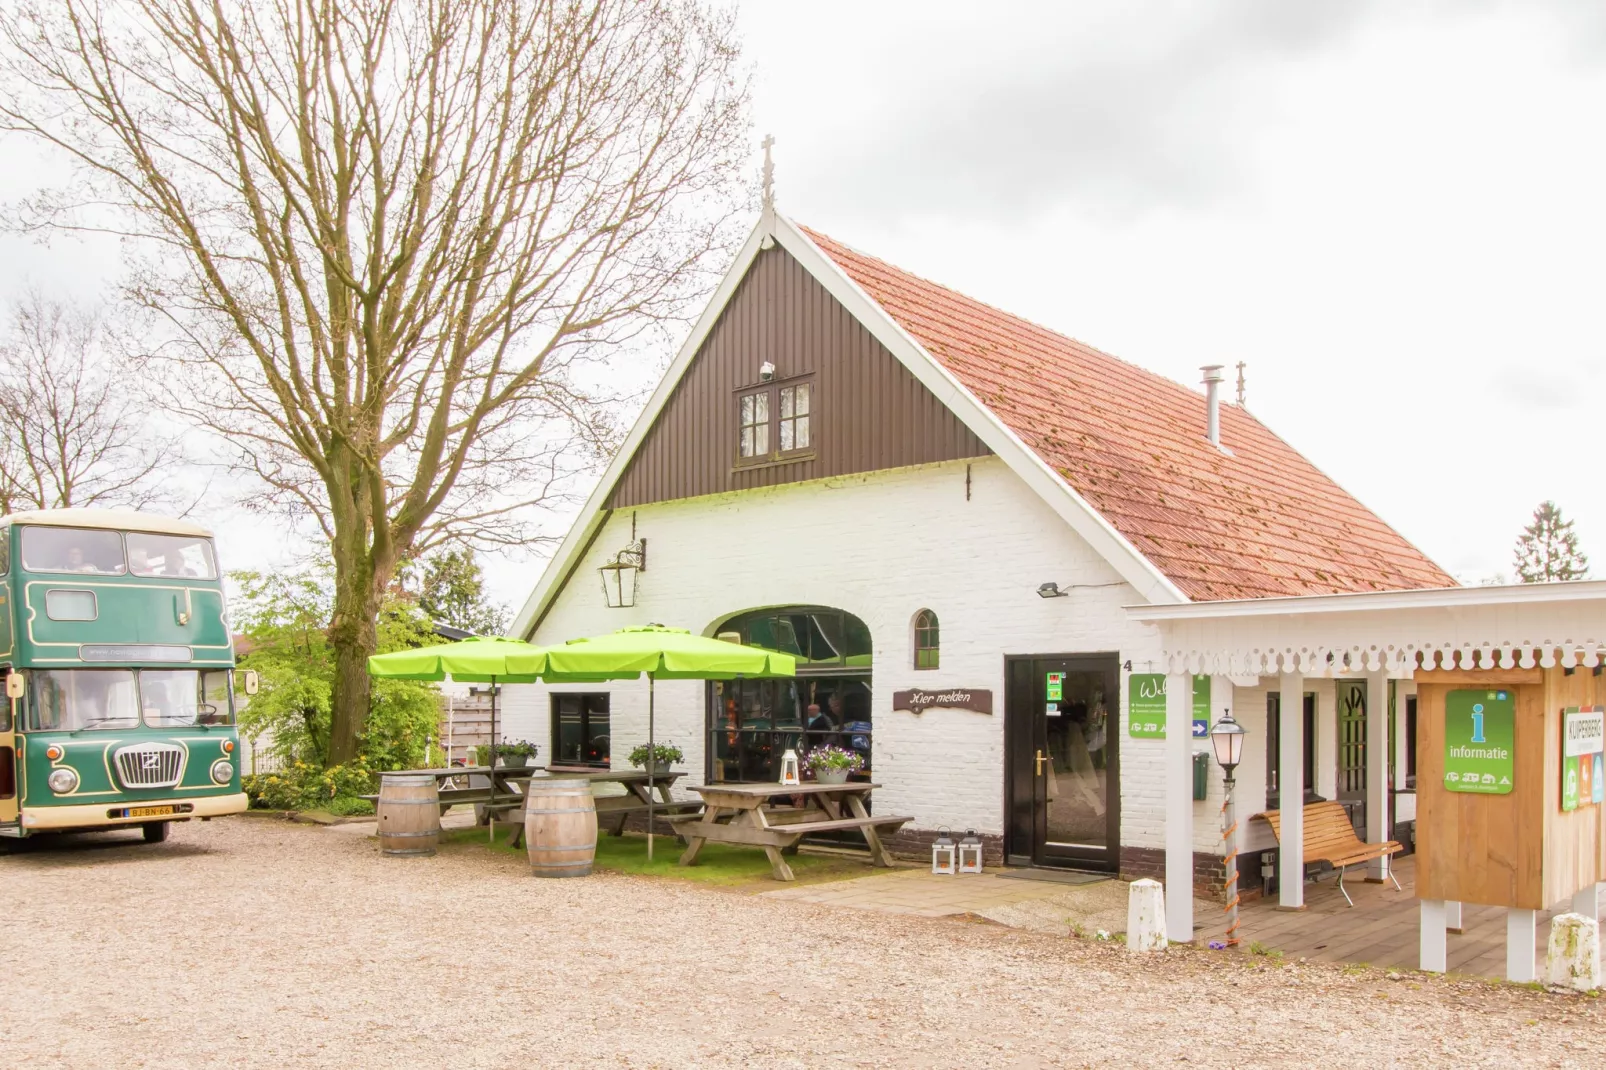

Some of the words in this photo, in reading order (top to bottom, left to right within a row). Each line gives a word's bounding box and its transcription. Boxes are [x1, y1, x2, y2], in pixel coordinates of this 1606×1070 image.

[1123, 659, 1132, 672] 4
[909, 692, 935, 704] Hier
[936, 690, 971, 703] melden
[1568, 719, 1601, 740] KUIPERBERG
[1450, 745, 1508, 760] informatie
[132, 807, 170, 817] BJ-BN-66
